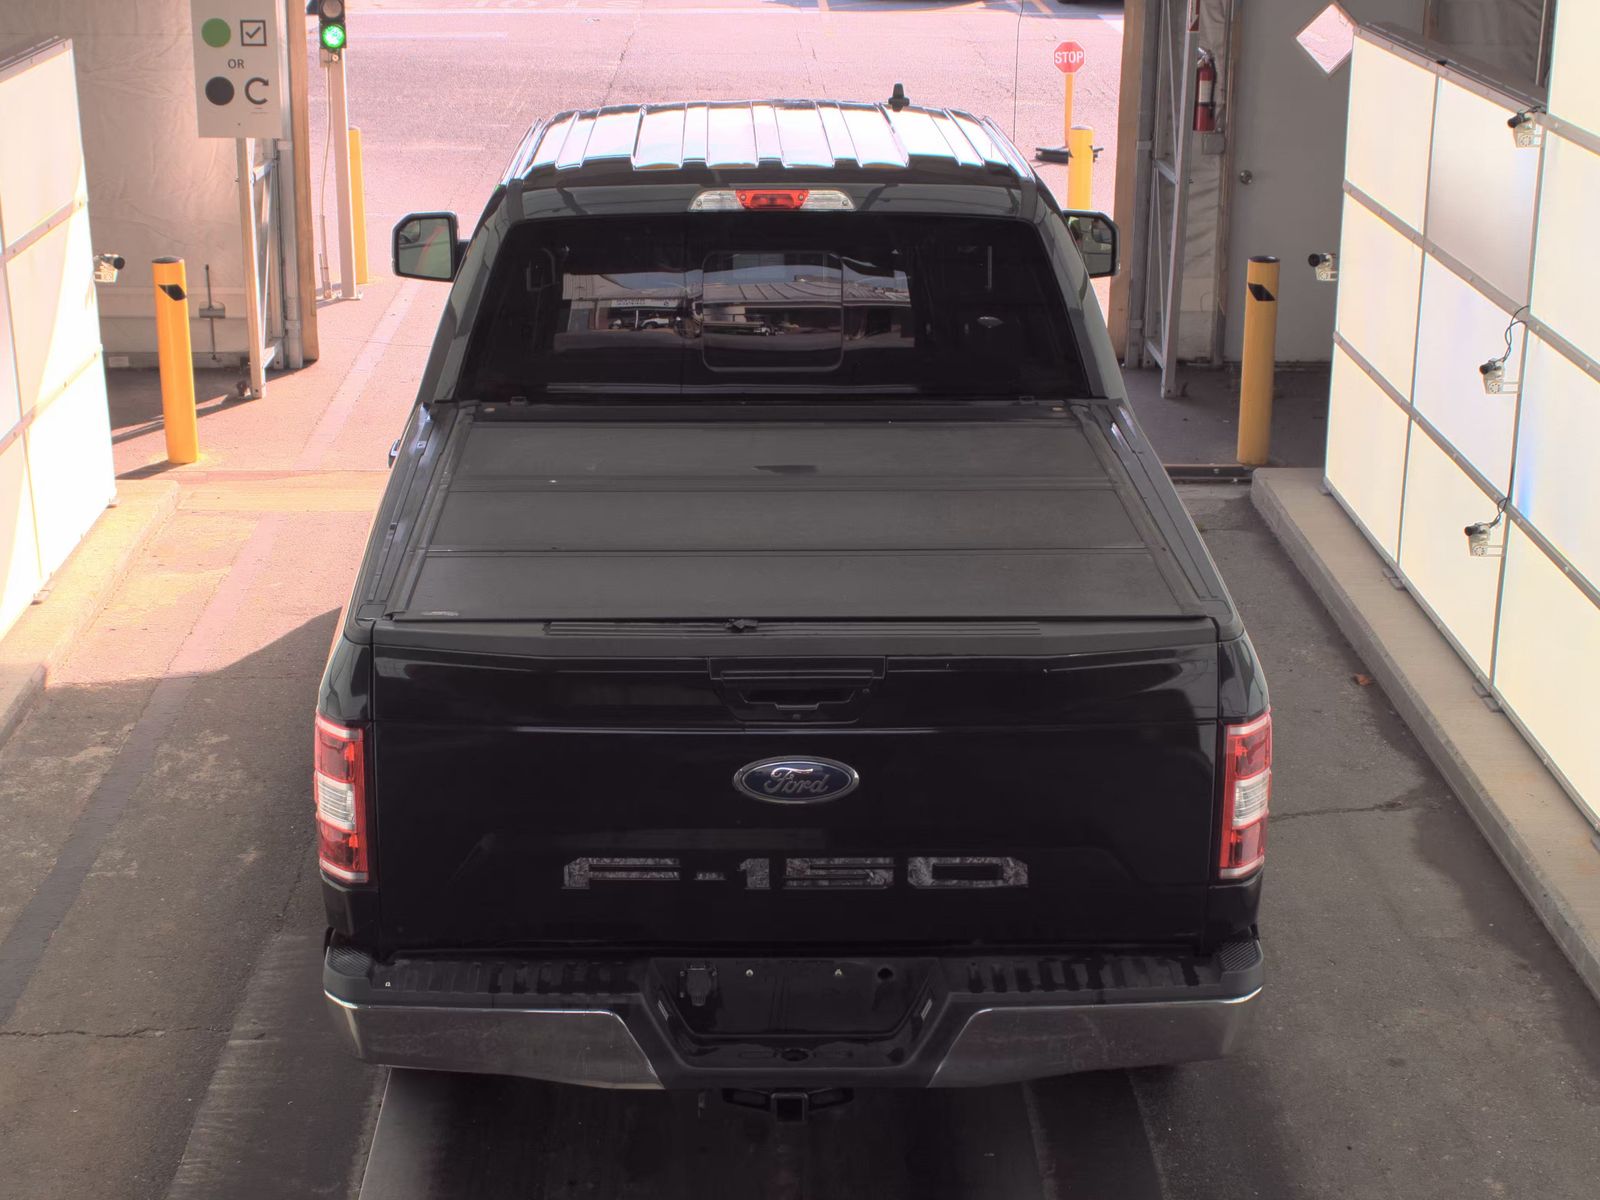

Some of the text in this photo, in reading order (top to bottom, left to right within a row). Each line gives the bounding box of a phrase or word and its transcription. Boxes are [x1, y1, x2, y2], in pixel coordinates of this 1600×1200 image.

[227, 58, 245, 69] OR
[1055, 51, 1084, 64] STOP
[764, 767, 830, 793] Ford
[562, 857, 1029, 890] F-150
